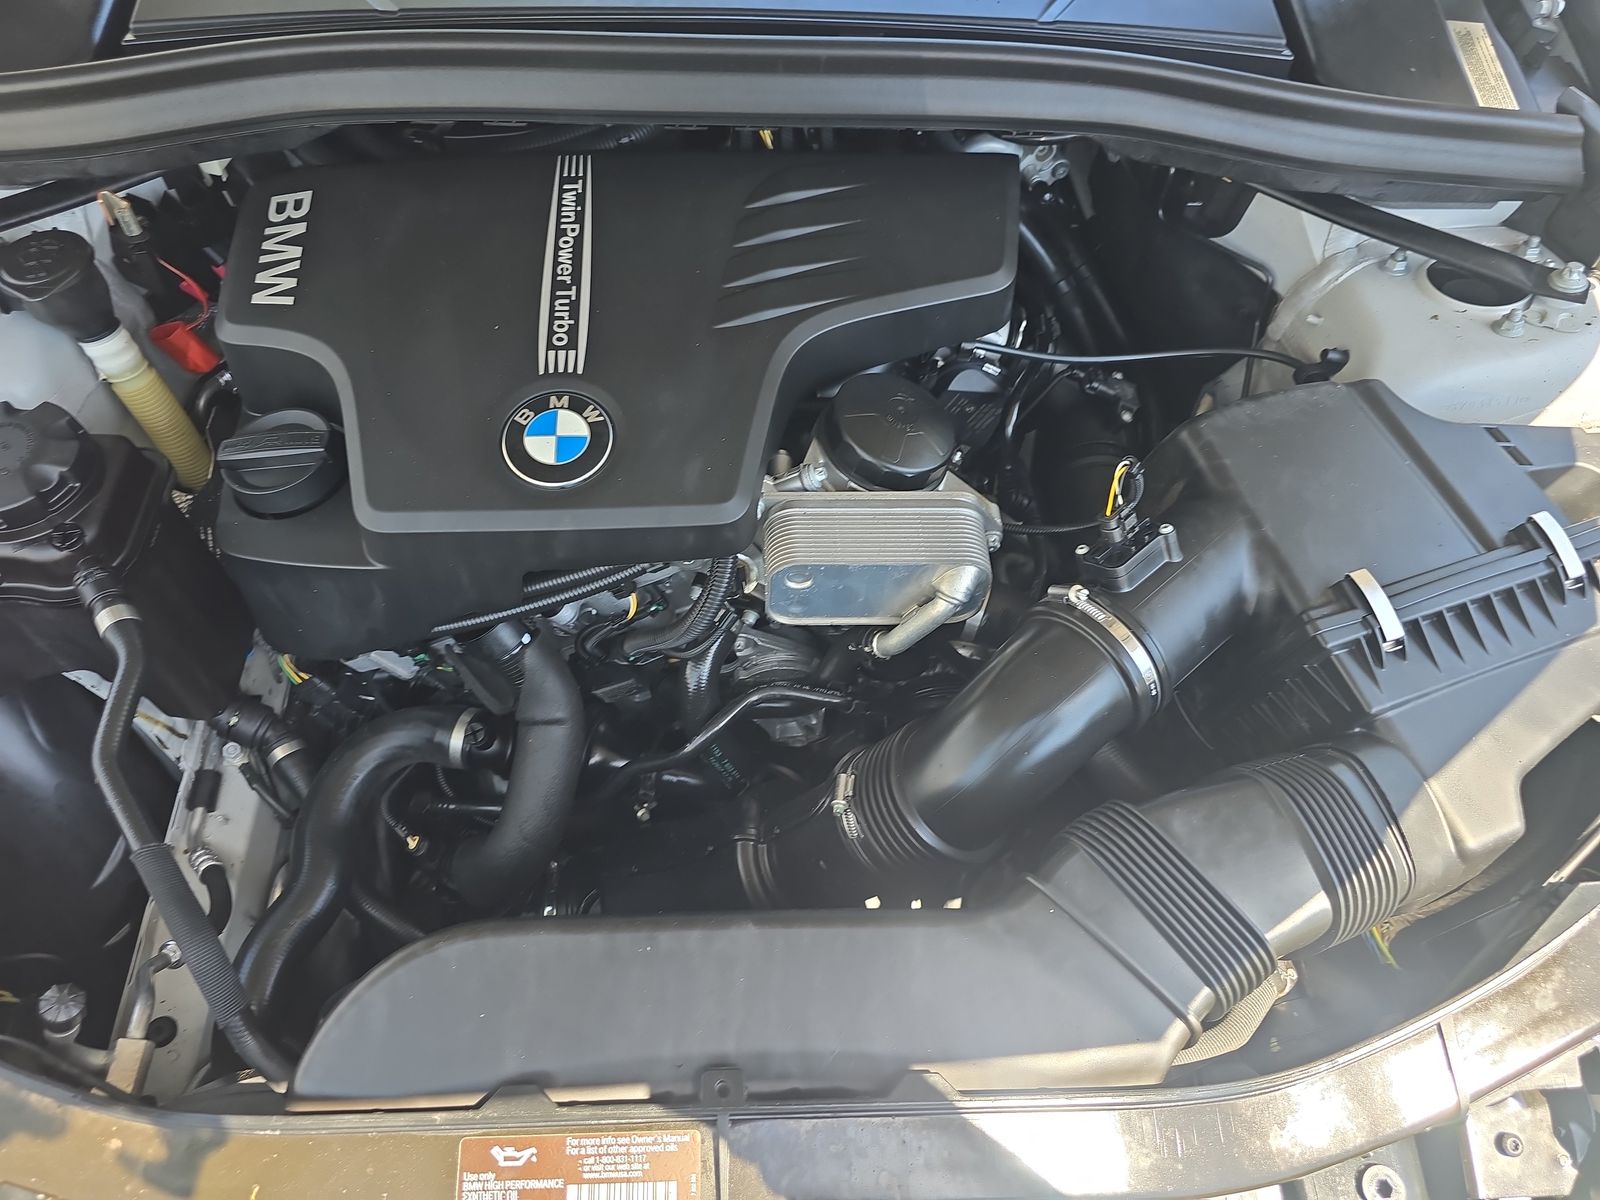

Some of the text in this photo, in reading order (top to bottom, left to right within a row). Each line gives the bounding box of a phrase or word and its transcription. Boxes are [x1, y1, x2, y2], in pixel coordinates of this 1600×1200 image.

[250, 189, 313, 305] BMW
[551, 179, 583, 347] TwinPower Turbo
[513, 395, 605, 426] BMW
[566, 1136, 579, 1147] For
[580, 1137, 600, 1146] more
[601, 1135, 616, 1146] info
[616, 1136, 630, 1145] see
[662, 1133, 690, 1143] Manual
[566, 1145, 579, 1155] For
[586, 1145, 599, 1155] list
[599, 1145, 608, 1154] of
[608, 1144, 628, 1154] other
[628, 1143, 663, 1155] approved
[664, 1142, 679, 1152] oils
[463, 1171, 496, 1183] Use only
[462, 1178, 565, 1191] BMW HIGH PERFORMANCE
